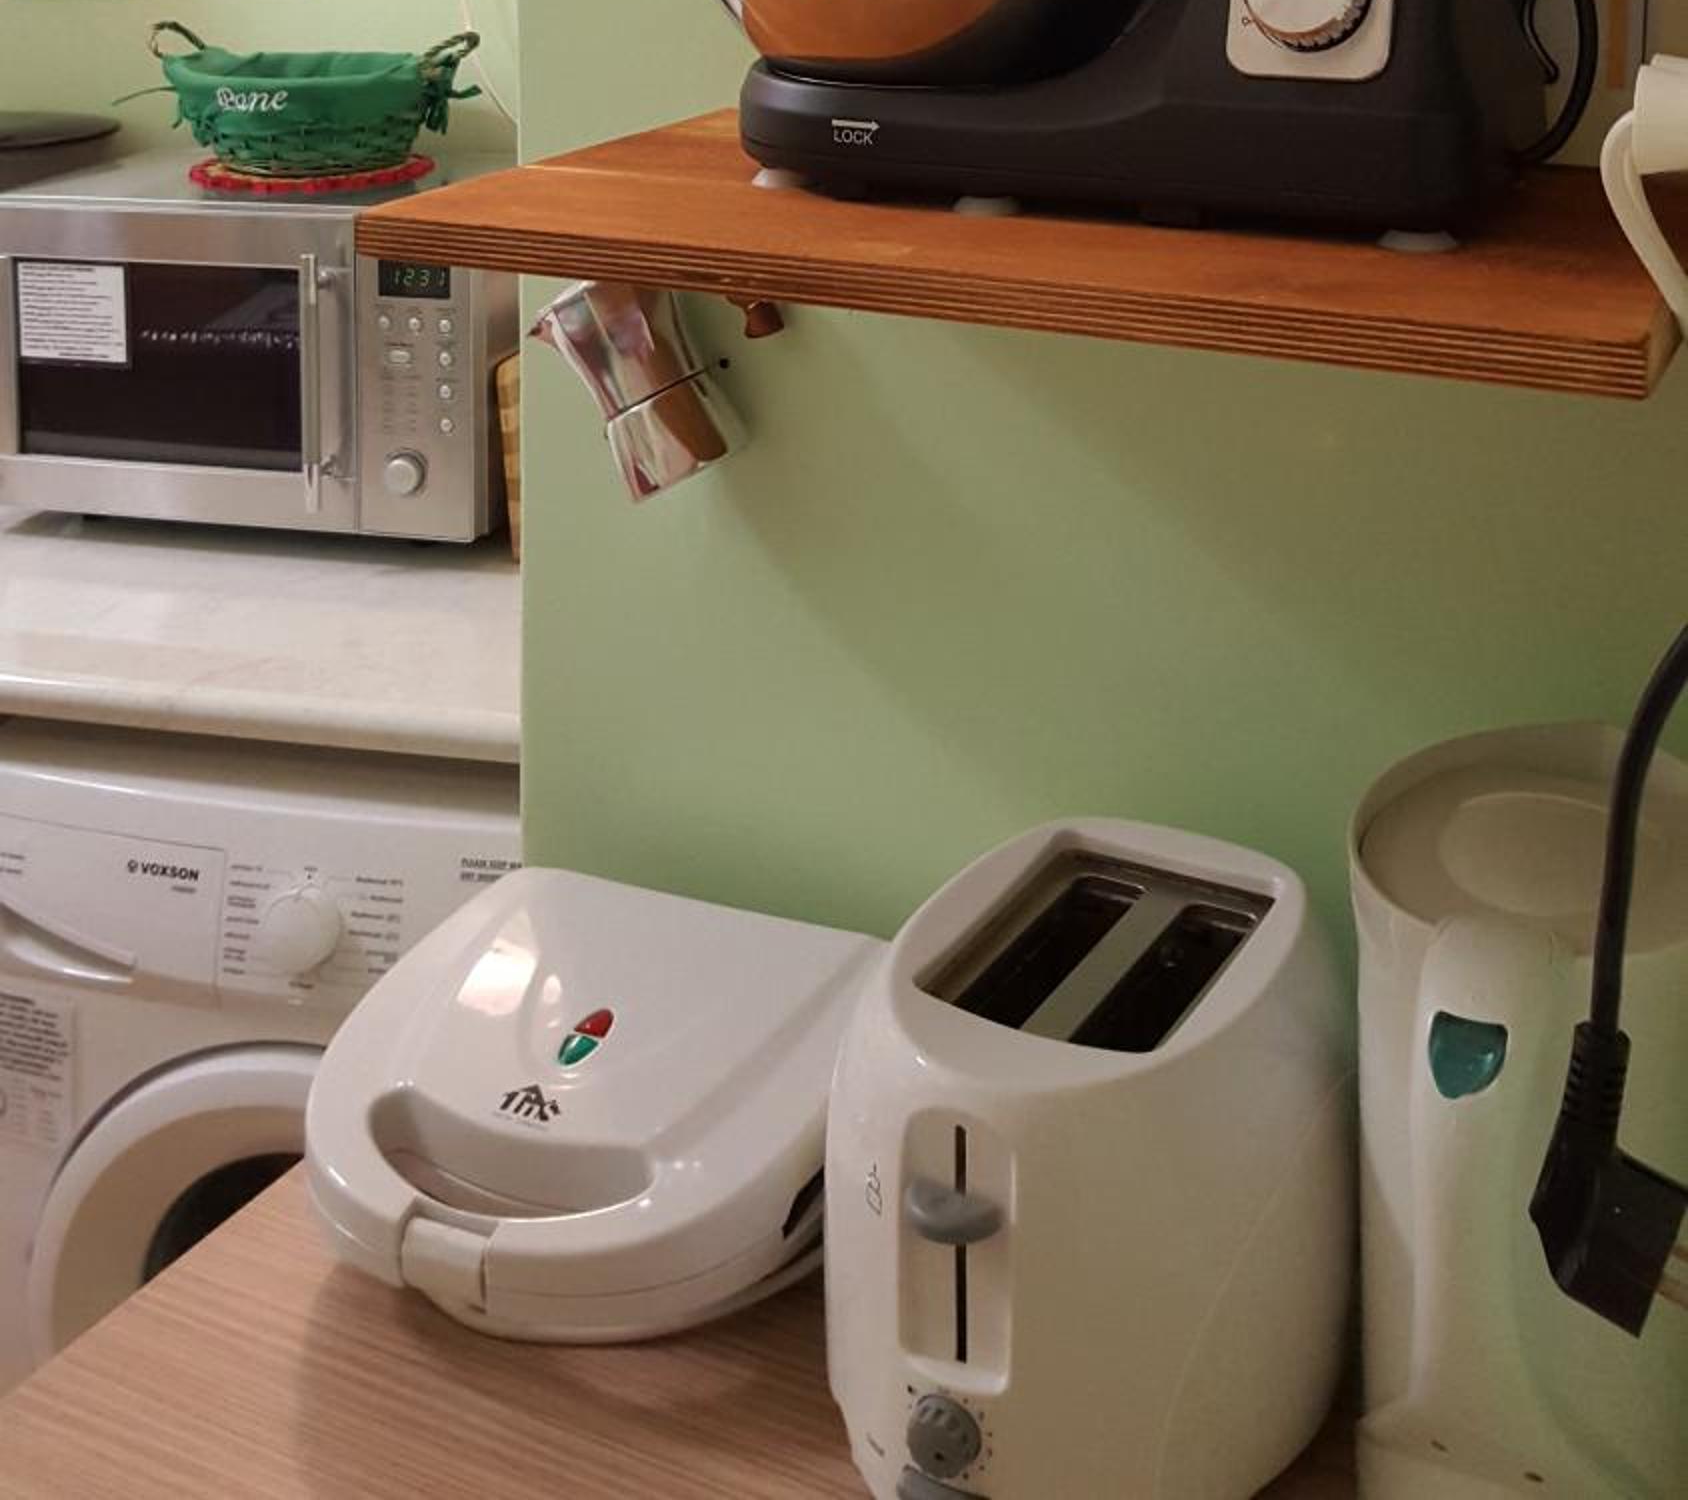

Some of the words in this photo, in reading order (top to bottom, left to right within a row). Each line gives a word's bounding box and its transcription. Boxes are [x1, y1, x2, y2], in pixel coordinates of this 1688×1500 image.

[216, 87, 289, 113] Pane
[833, 129, 874, 145] LOCK
[141, 862, 199, 882] VOXSON
